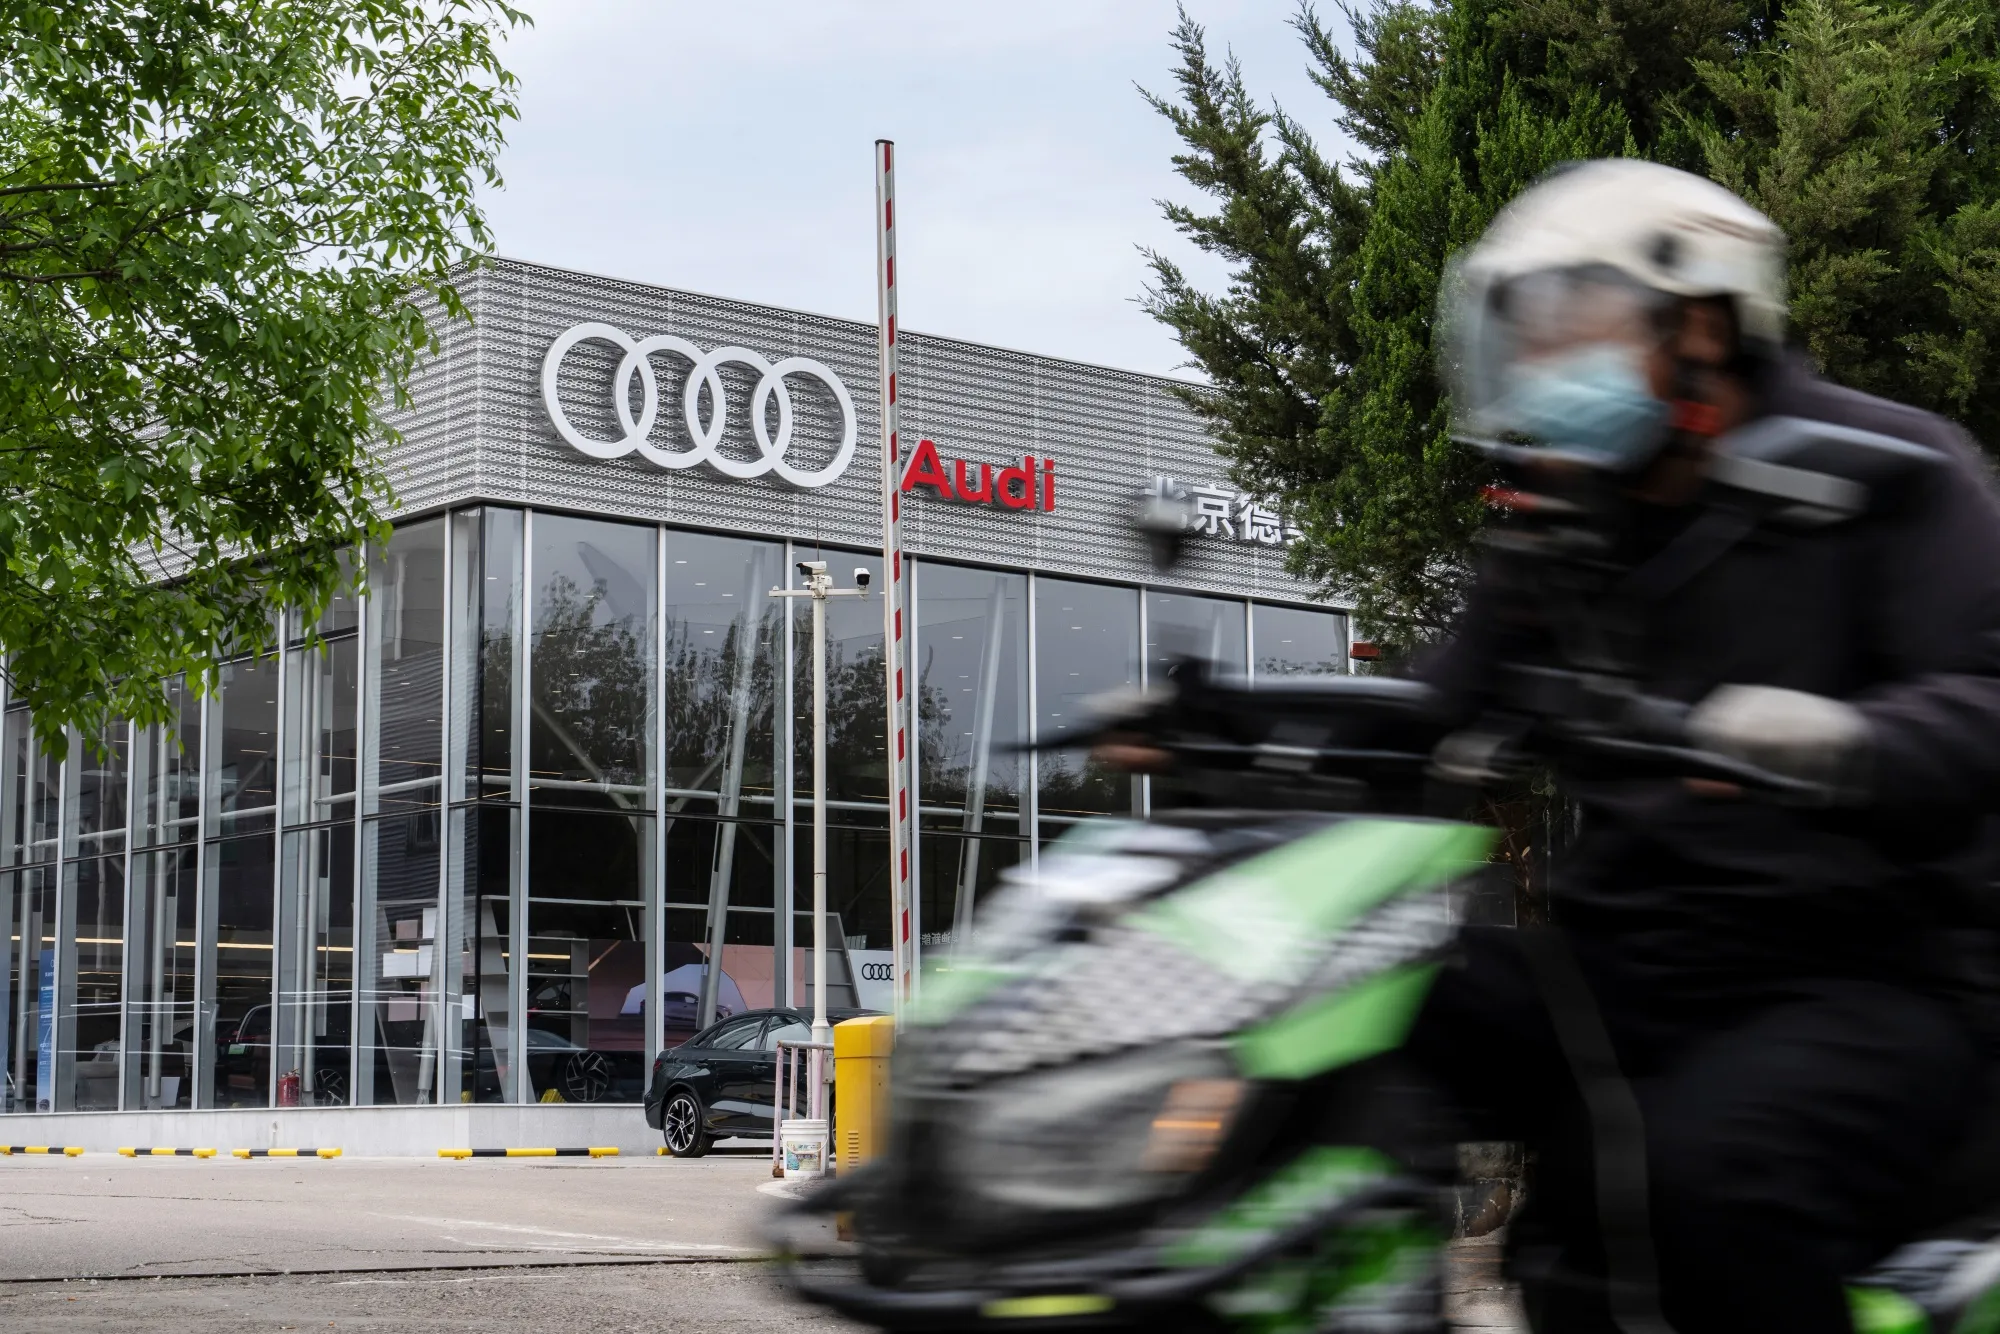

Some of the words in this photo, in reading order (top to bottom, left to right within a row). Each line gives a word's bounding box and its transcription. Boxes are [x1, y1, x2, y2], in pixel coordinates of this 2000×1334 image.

[901, 438, 1055, 512] Audi
[1140, 475, 1306, 546] 北京德
